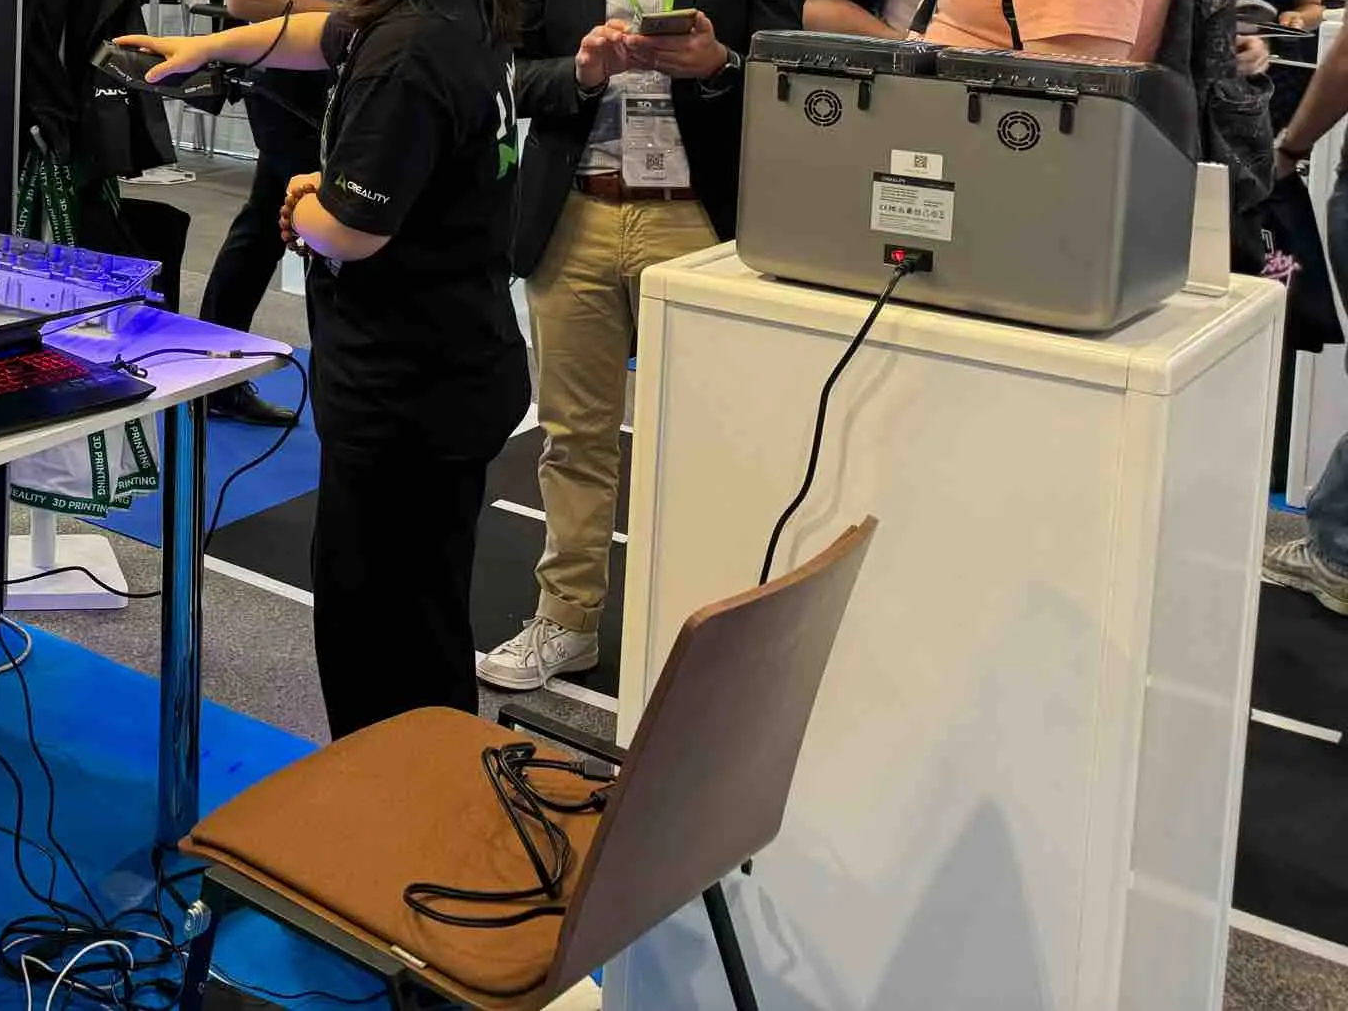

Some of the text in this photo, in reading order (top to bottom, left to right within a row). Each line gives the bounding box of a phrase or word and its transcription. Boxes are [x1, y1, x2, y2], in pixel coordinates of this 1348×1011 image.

[346, 179, 391, 205] CREALITY
[129, 425, 151, 469] PRINTING
[91, 435, 107, 496] 3D PRINTING
[116, 475, 156, 491] RINTING
[51, 497, 66, 508] 3D
